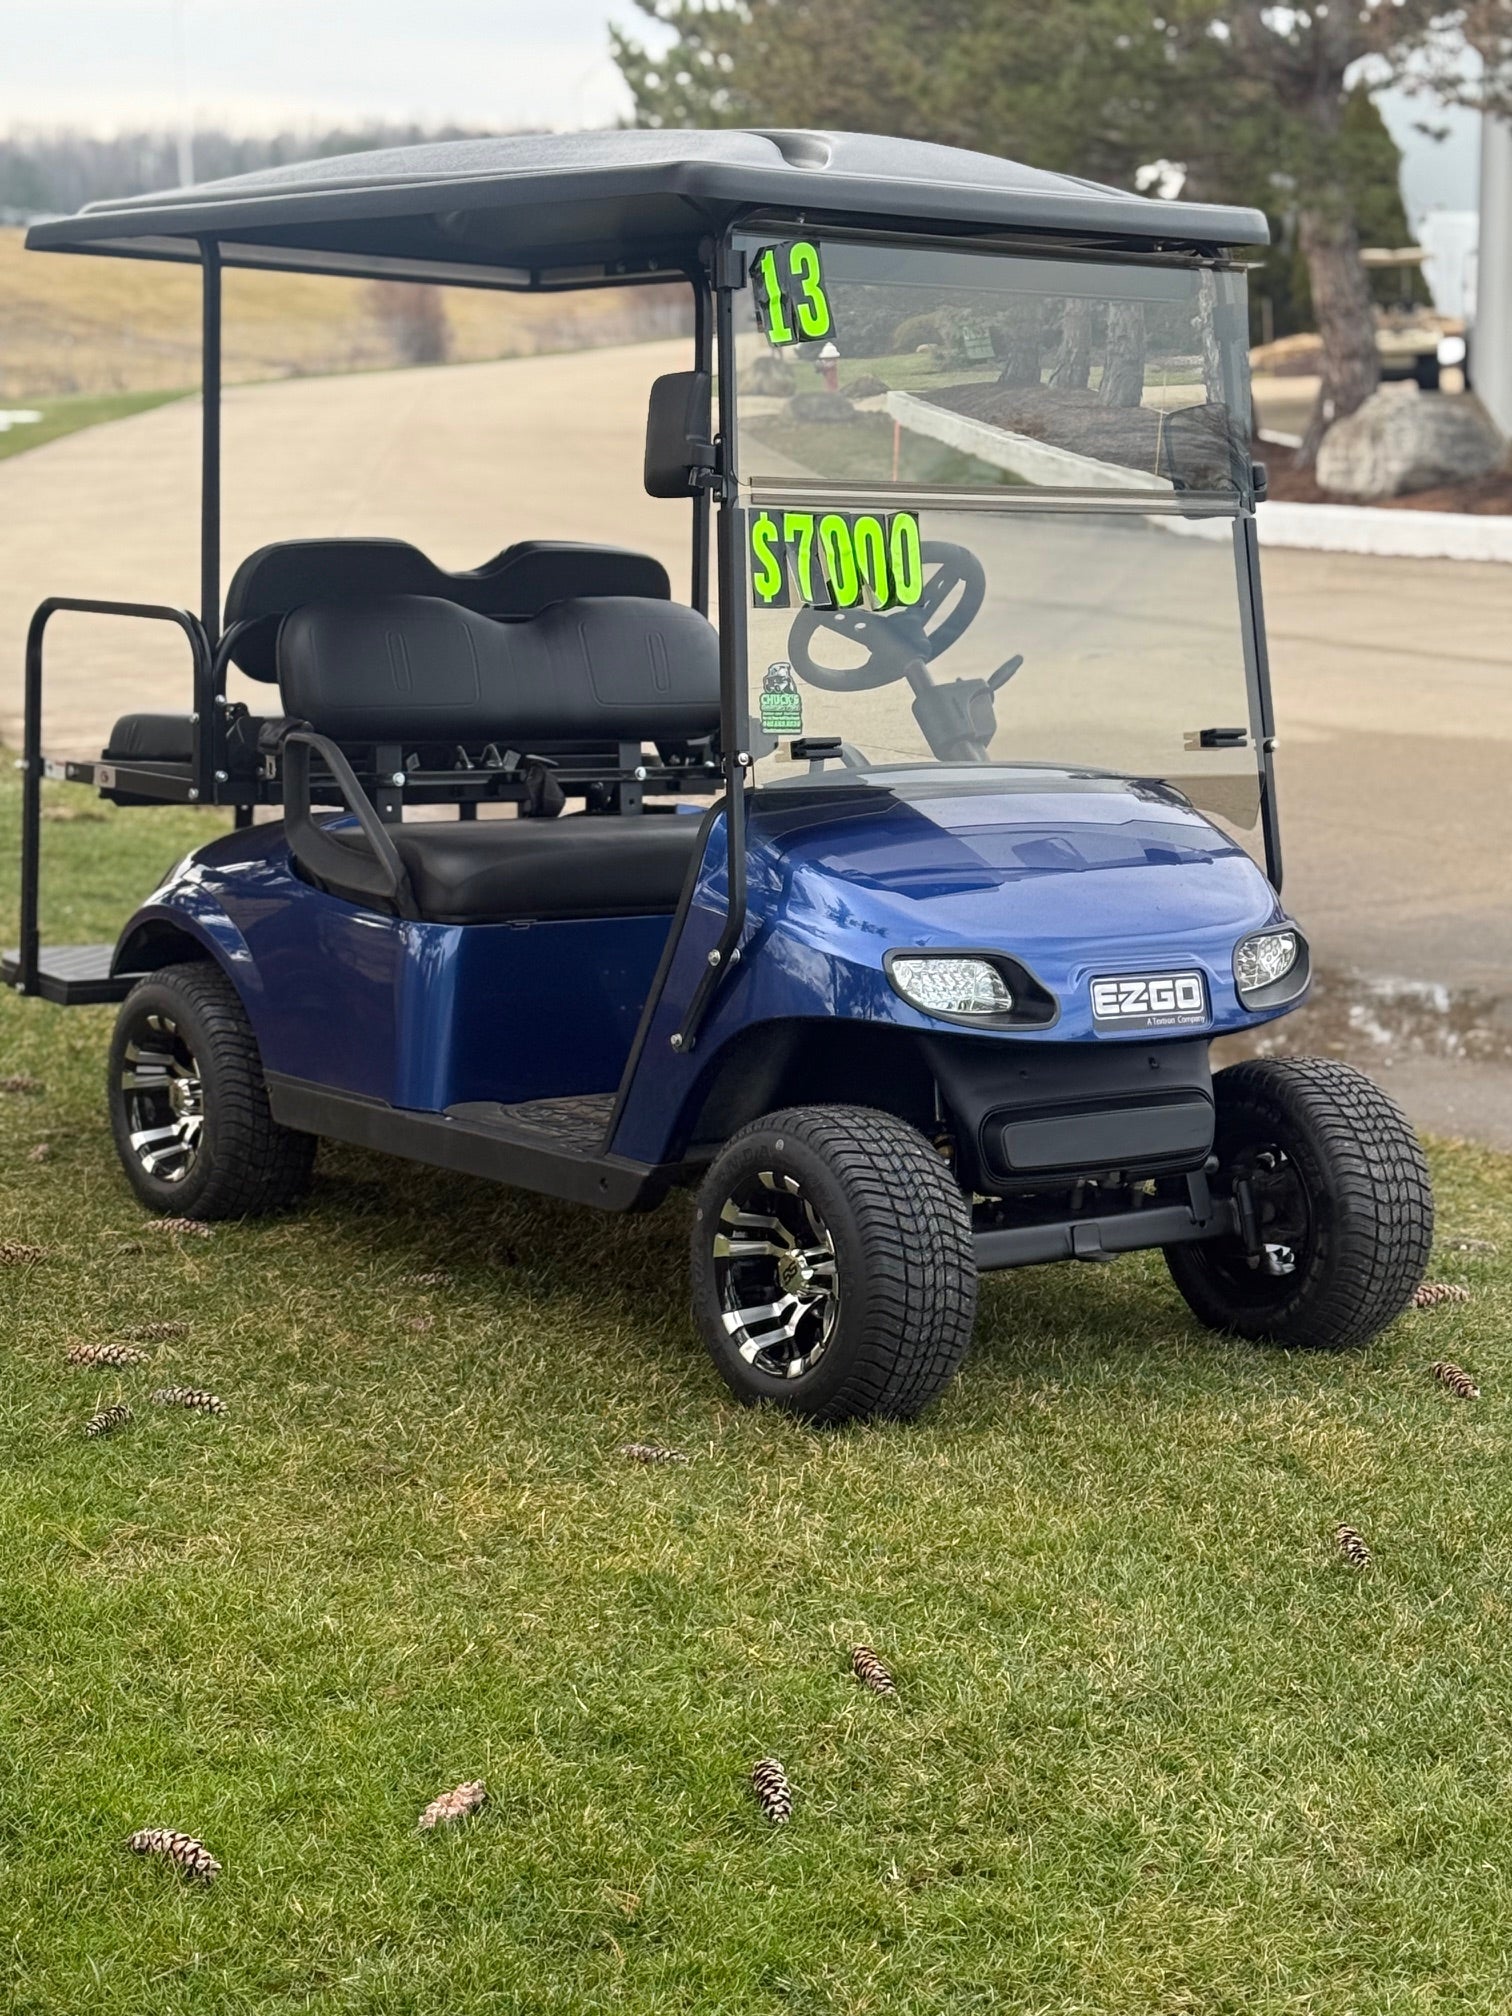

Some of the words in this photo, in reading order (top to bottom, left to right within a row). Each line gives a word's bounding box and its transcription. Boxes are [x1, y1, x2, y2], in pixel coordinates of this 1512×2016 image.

[761, 241, 830, 344] 13
[752, 511, 923, 609] $7000
[1147, 1018, 1153, 1026] A
[1177, 1015, 1206, 1024] Company
